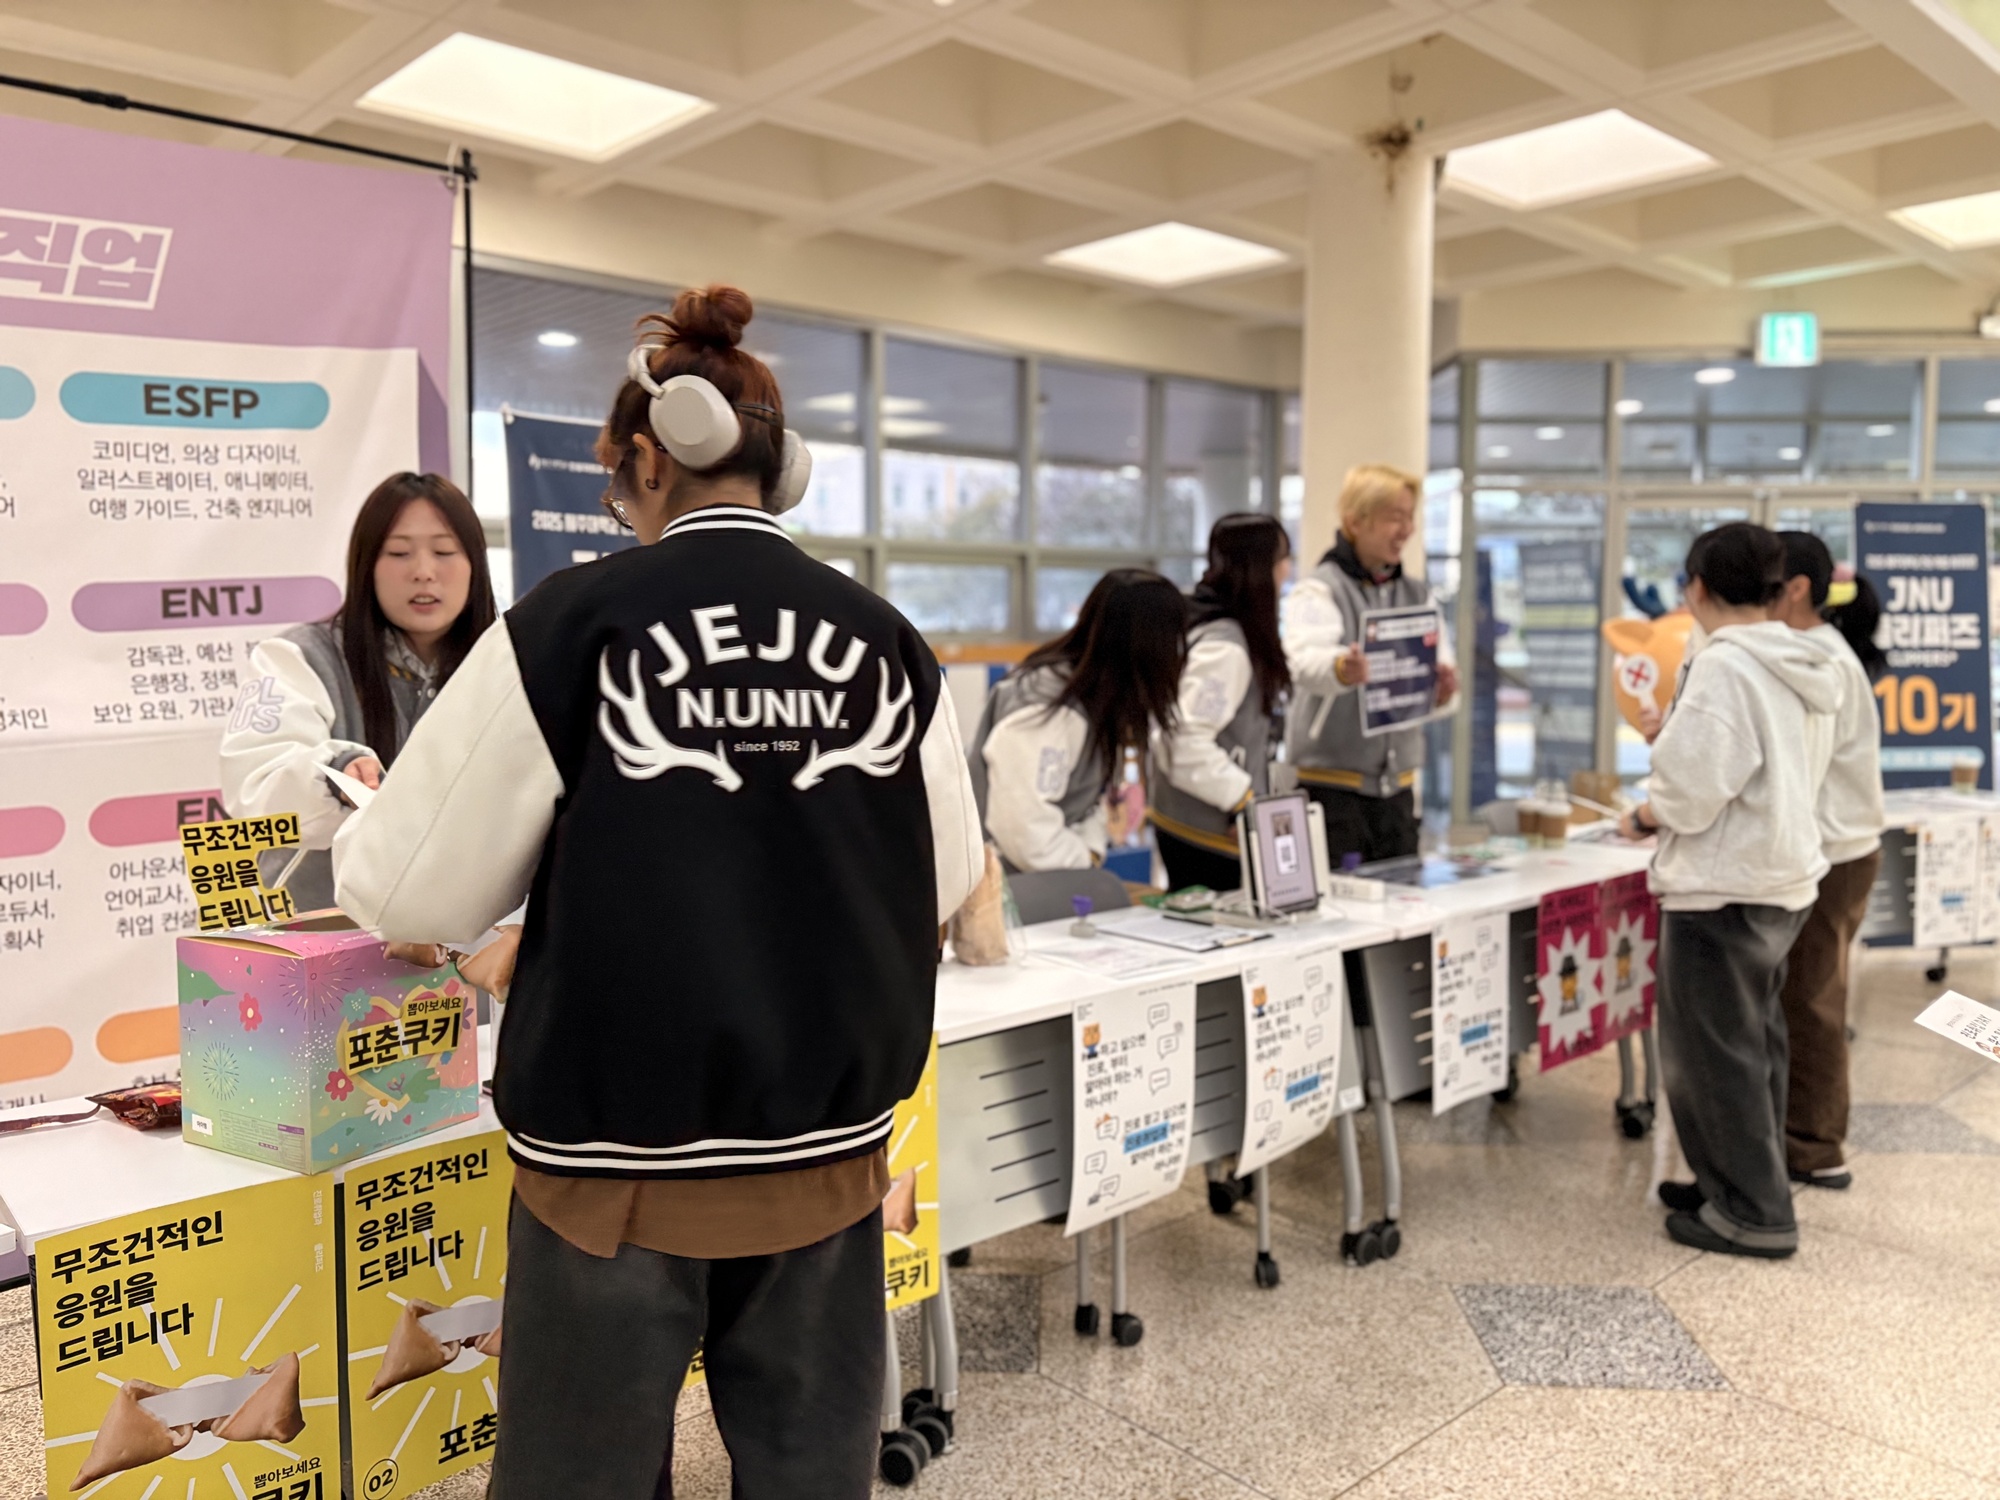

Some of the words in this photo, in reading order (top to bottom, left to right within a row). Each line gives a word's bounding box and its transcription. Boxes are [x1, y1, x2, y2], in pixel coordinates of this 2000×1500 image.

[144, 383, 259, 419] ESFP
[93, 440, 176, 464] 코미디언,
[183, 443, 220, 465] 의상
[227, 444, 301, 465] 디자이너,
[77, 468, 218, 491] 일러스트레이터,
[225, 470, 313, 491] 애니메이터,
[89, 497, 127, 520] 여행
[135, 497, 198, 520] 가이드,
[205, 498, 242, 519] 건축
[247, 497, 313, 518] 엔지니어
[161, 585, 263, 619] ENTJ
[1886, 576, 1954, 612] JNU
[127, 644, 191, 667] 감독관,
[197, 642, 233, 662] 예산
[646, 603, 868, 687] JEJU
[131, 672, 195, 695] 은행장,
[200, 669, 238, 691] 정책
[94, 703, 131, 724] 보안
[140, 699, 183, 721] 요원,
[676, 688, 850, 729] N.UNIV.
[1873, 674, 1977, 735] 10기
[734, 741, 768, 752] since
[771, 740, 800, 752] 1952
[183, 815, 300, 856] 무조건적인
[191, 859, 259, 895] 응원을
[105, 884, 188, 911] 언어교사,
[200, 890, 293, 931] 드립니다
[116, 914, 154, 939] 취업
[408, 997, 461, 1016] 뽑아보세요
[349, 1013, 461, 1070] 포춘쿠키
[355, 1149, 488, 1211] 무조건적인
[356, 1201, 435, 1252] 응원을
[51, 1210, 223, 1284] 무조건적인
[357, 1230, 464, 1291] 드립니다
[885, 1260, 928, 1298] 쿠키
[53, 1271, 157, 1329] 응원을
[56, 1302, 194, 1373] 드립니다
[254, 1457, 321, 1488] 뽑아보세요
[369, 1468, 393, 1493] 02
